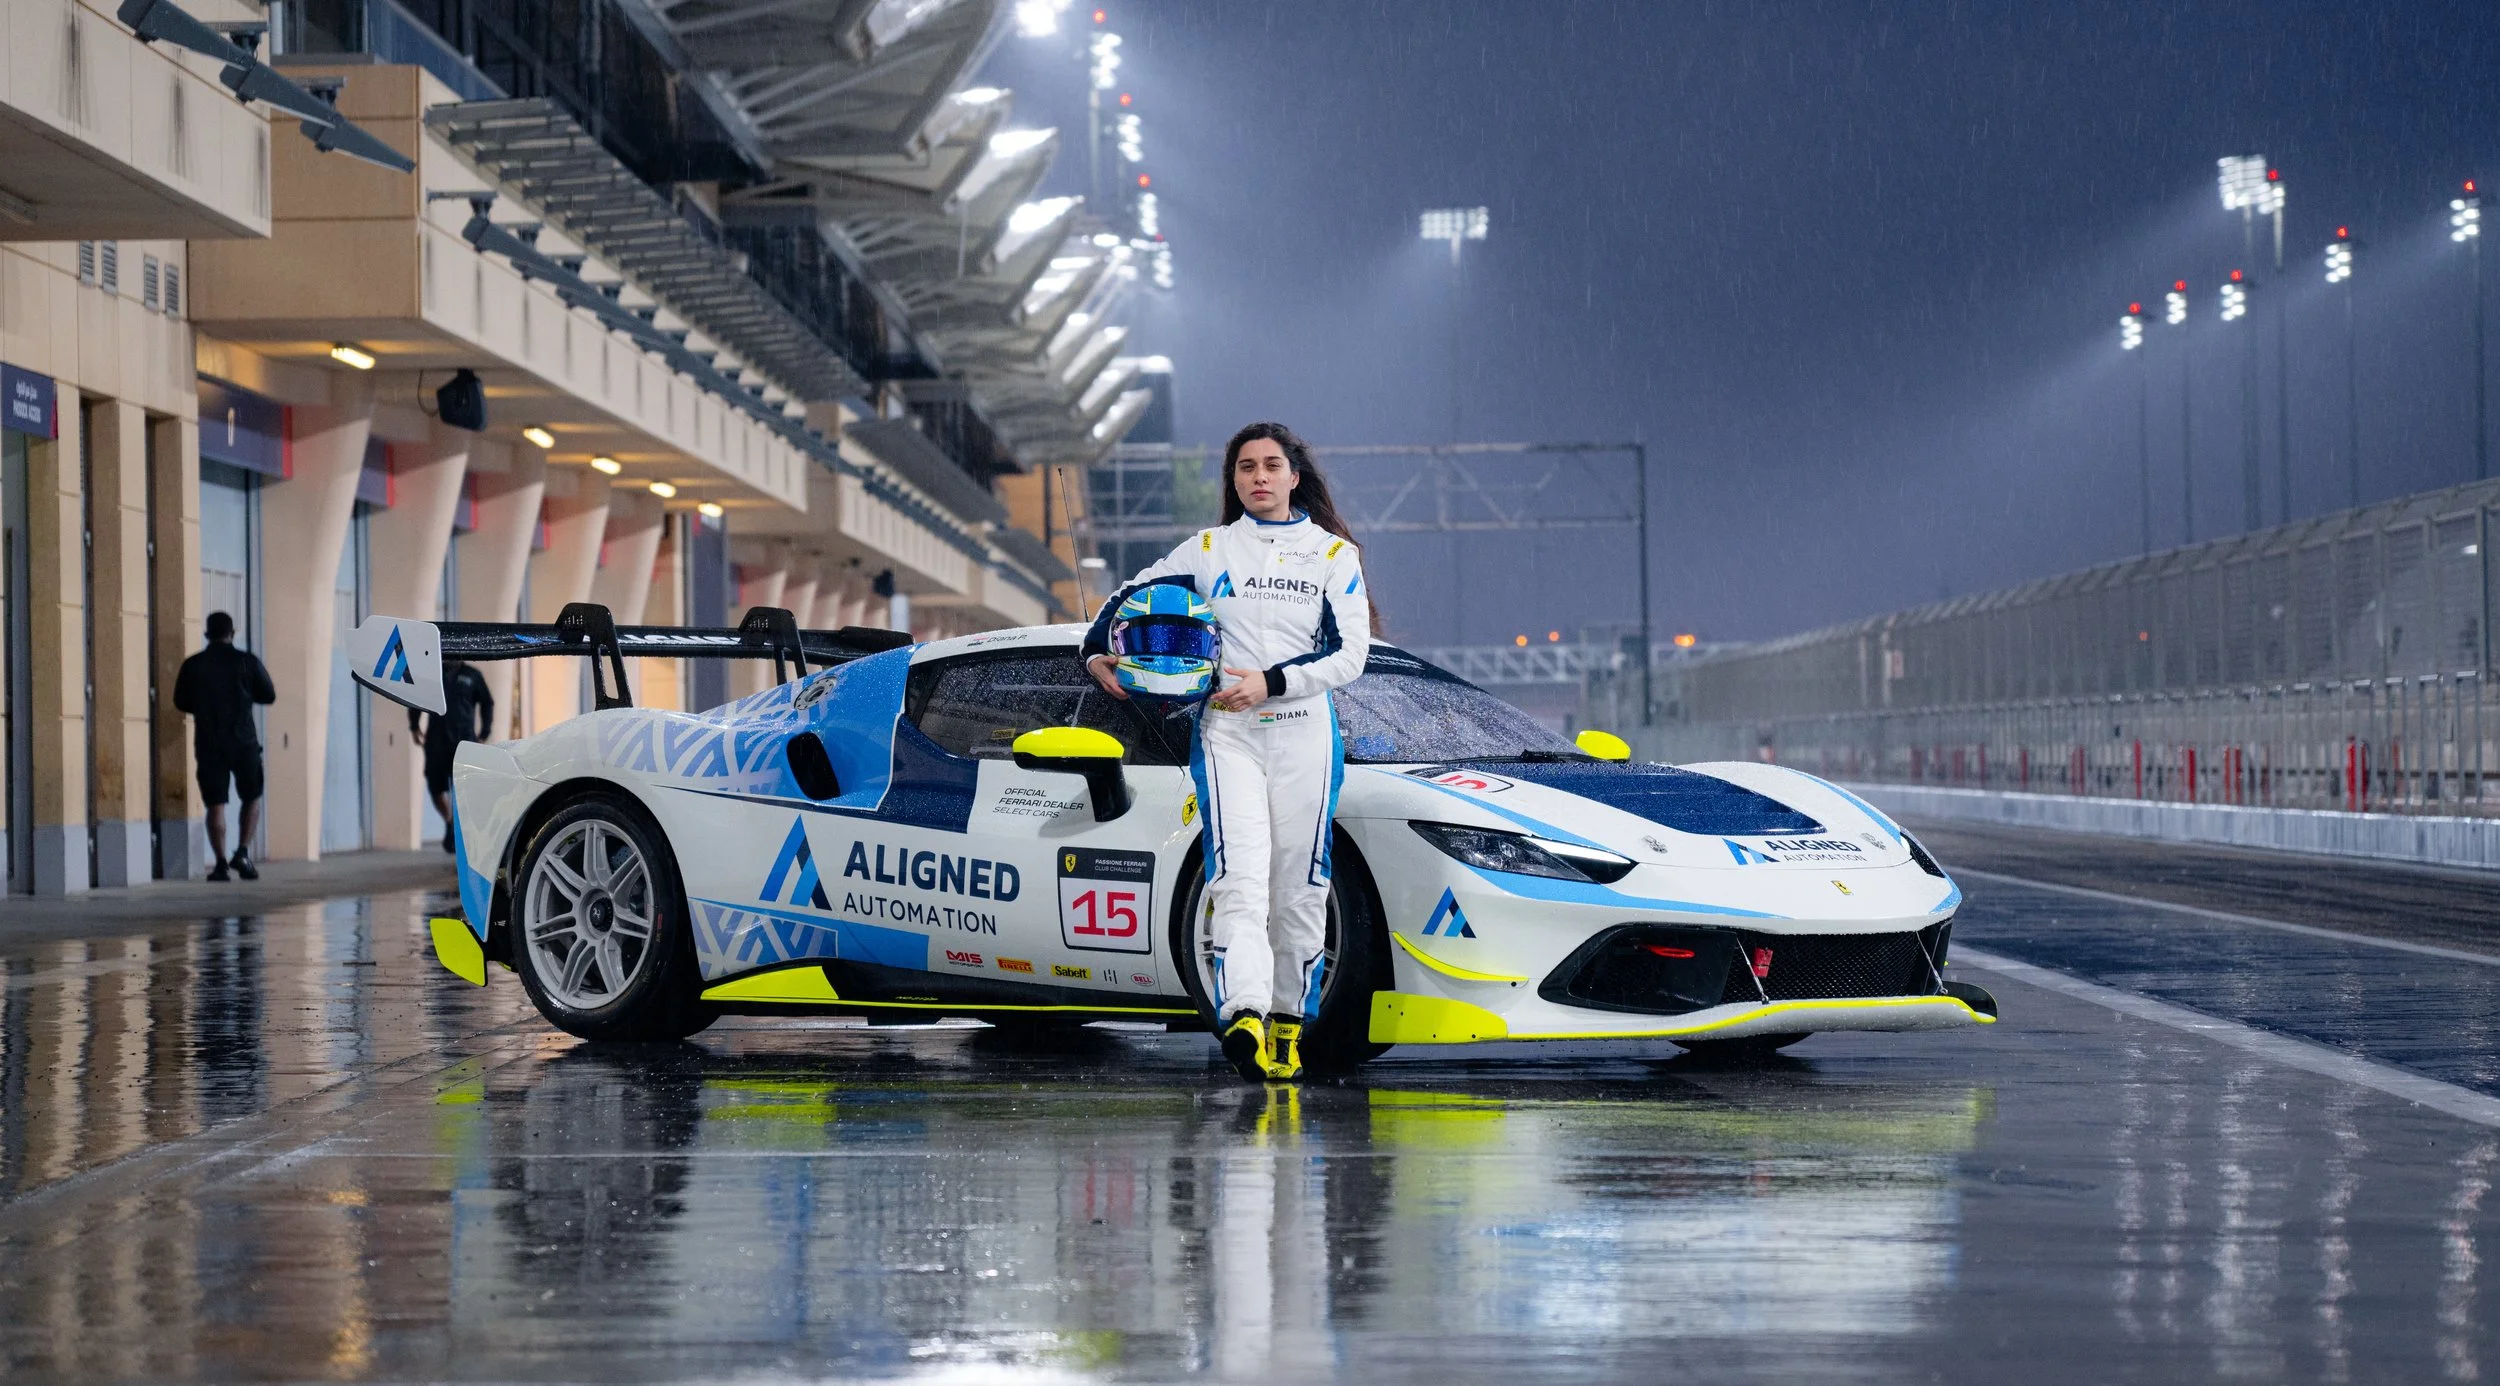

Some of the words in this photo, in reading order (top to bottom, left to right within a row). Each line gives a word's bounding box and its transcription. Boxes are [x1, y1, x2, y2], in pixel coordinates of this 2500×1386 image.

[1245, 577, 1318, 597] ALIGNED
[1242, 591, 1310, 606] AUTOMATION
[1276, 709, 1309, 721] DIANA
[1004, 787, 1048, 798] OFFICIAL
[998, 797, 1042, 807] FERRARI
[1043, 800, 1085, 811] DEALER
[992, 806, 1032, 816] SELECT
[1032, 809, 1061, 819] CARS
[1764, 840, 1863, 852] ALIGNED
[1095, 858, 1123, 866] PASSIONE
[1123, 860, 1148, 868] FERRARI
[1783, 853, 1868, 862] AUTOMATION
[843, 841, 1021, 903] ALIGNED
[1109, 866, 1142, 874] CHALLENGE
[843, 892, 998, 936] AUTOMATION
[1072, 890, 1138, 937] 15
[997, 958, 1033, 972] PIRELLI
[1054, 965, 1089, 979] Sabelt
[1133, 975, 1152, 983] BELL
[1277, 1027, 1293, 1035] OMP
